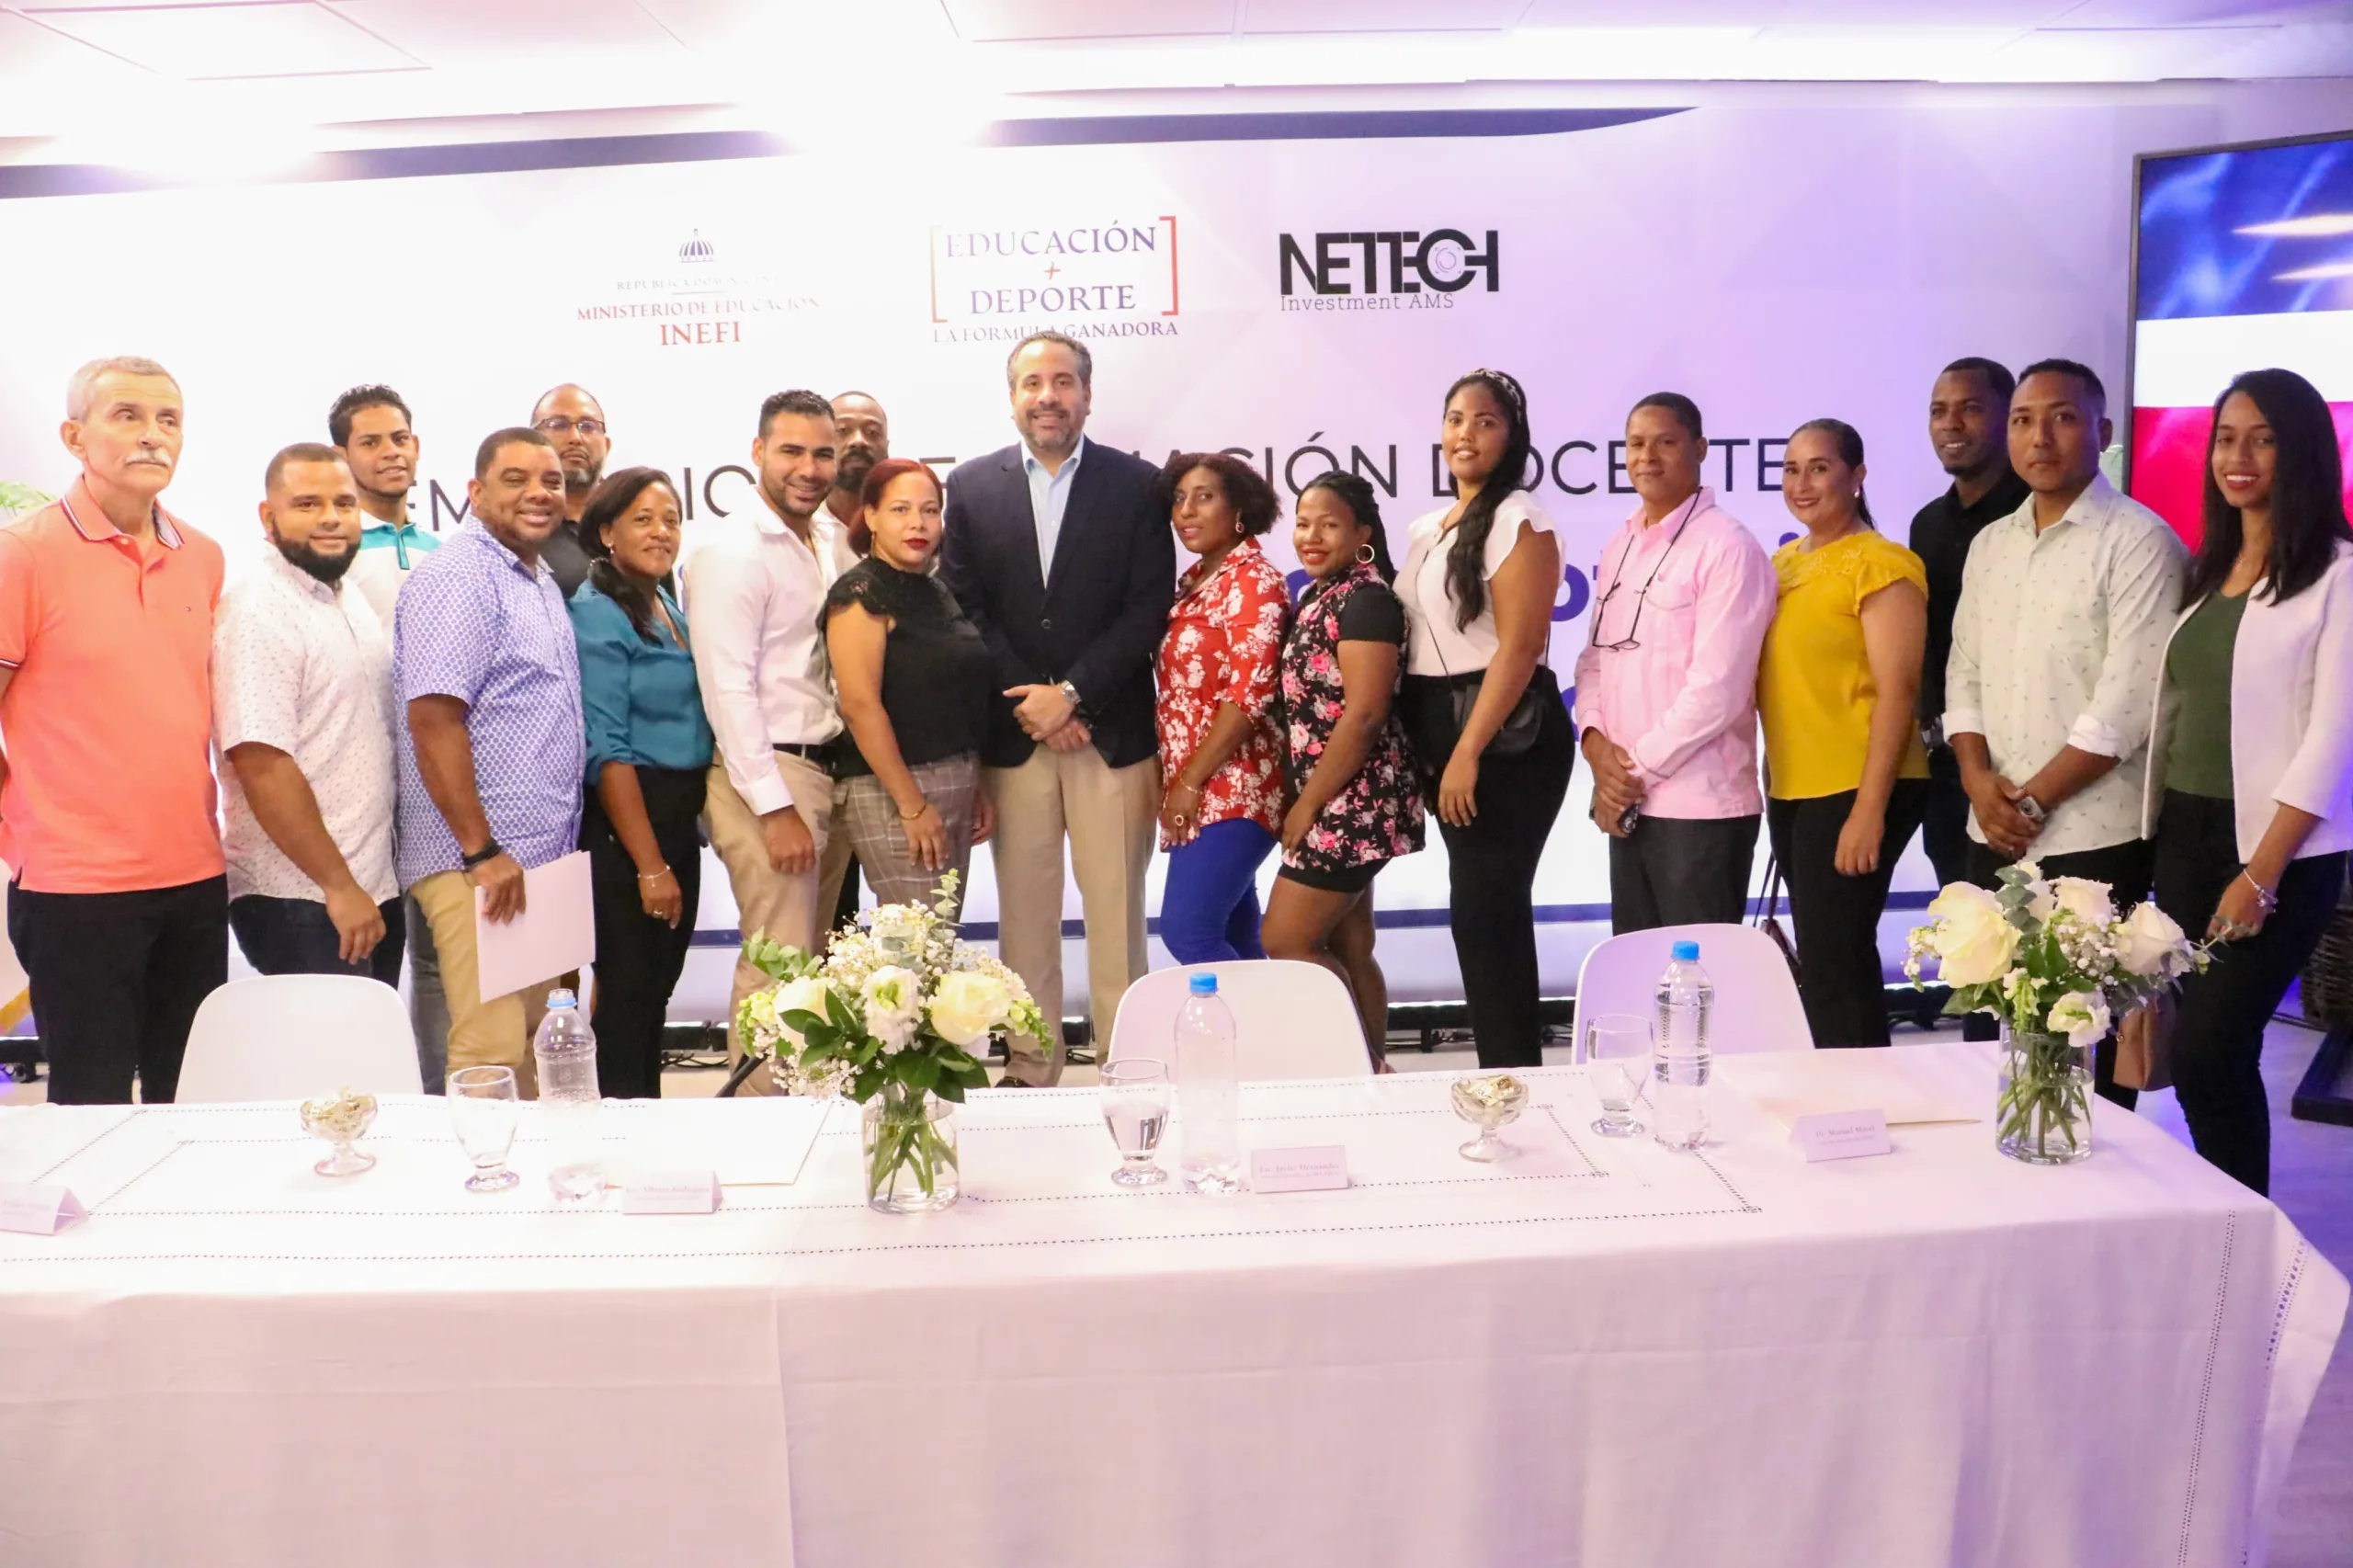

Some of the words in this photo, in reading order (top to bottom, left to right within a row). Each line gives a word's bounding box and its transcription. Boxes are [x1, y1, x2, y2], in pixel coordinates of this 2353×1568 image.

[947, 219, 1156, 257] EDUCACIÓN
[577, 301, 683, 321] MINISTERIO
[688, 301, 709, 315] DE
[970, 284, 1136, 314] DEPORTE
[1280, 294, 1401, 312] Investment
[1409, 292, 1454, 310] AMS
[659, 321, 741, 346] INEFI
[933, 328, 958, 344] LA
[1063, 321, 1179, 339] GANADORA
[1433, 438, 1790, 497] CETE
